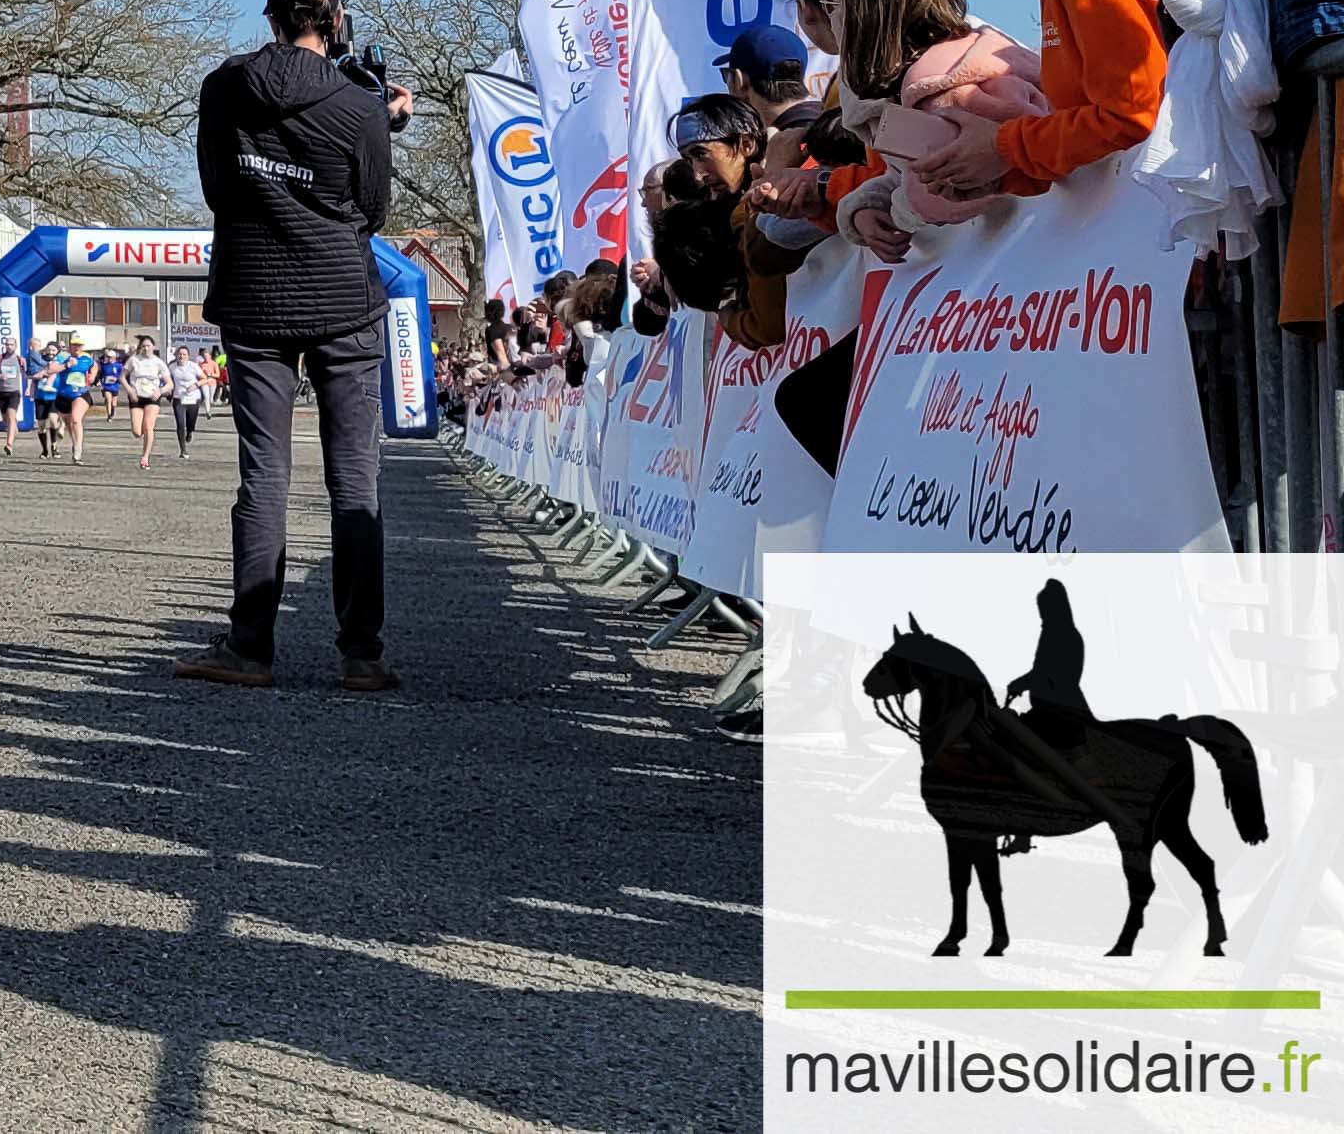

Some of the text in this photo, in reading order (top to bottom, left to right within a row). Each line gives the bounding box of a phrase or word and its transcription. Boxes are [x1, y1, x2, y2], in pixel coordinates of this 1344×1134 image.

[395, 308, 417, 403] INTERSPORT
[920, 367, 1040, 491] Ville et Agglo
[867, 456, 896, 522] Le
[968, 454, 1078, 554] Vendée
